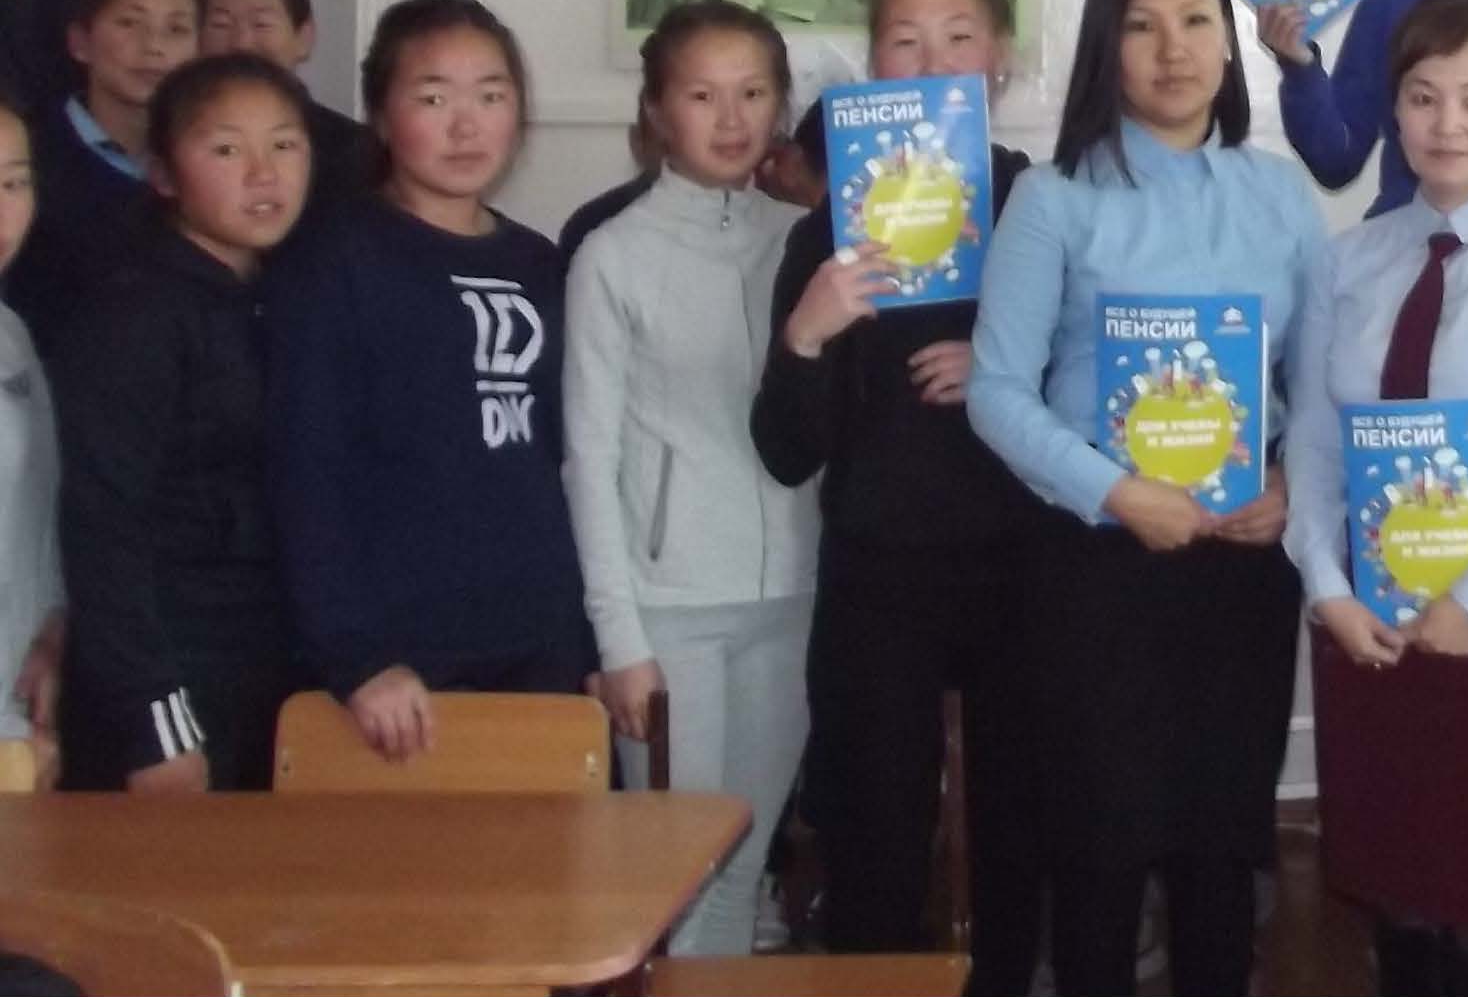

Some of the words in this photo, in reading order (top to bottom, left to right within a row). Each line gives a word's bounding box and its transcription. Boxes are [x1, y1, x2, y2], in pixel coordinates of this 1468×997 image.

[833, 105, 924, 127] ПЕНСИИ
[1105, 319, 1197, 339] ПЕНСИИ
[1352, 428, 1446, 447] ПЕНСИИ
